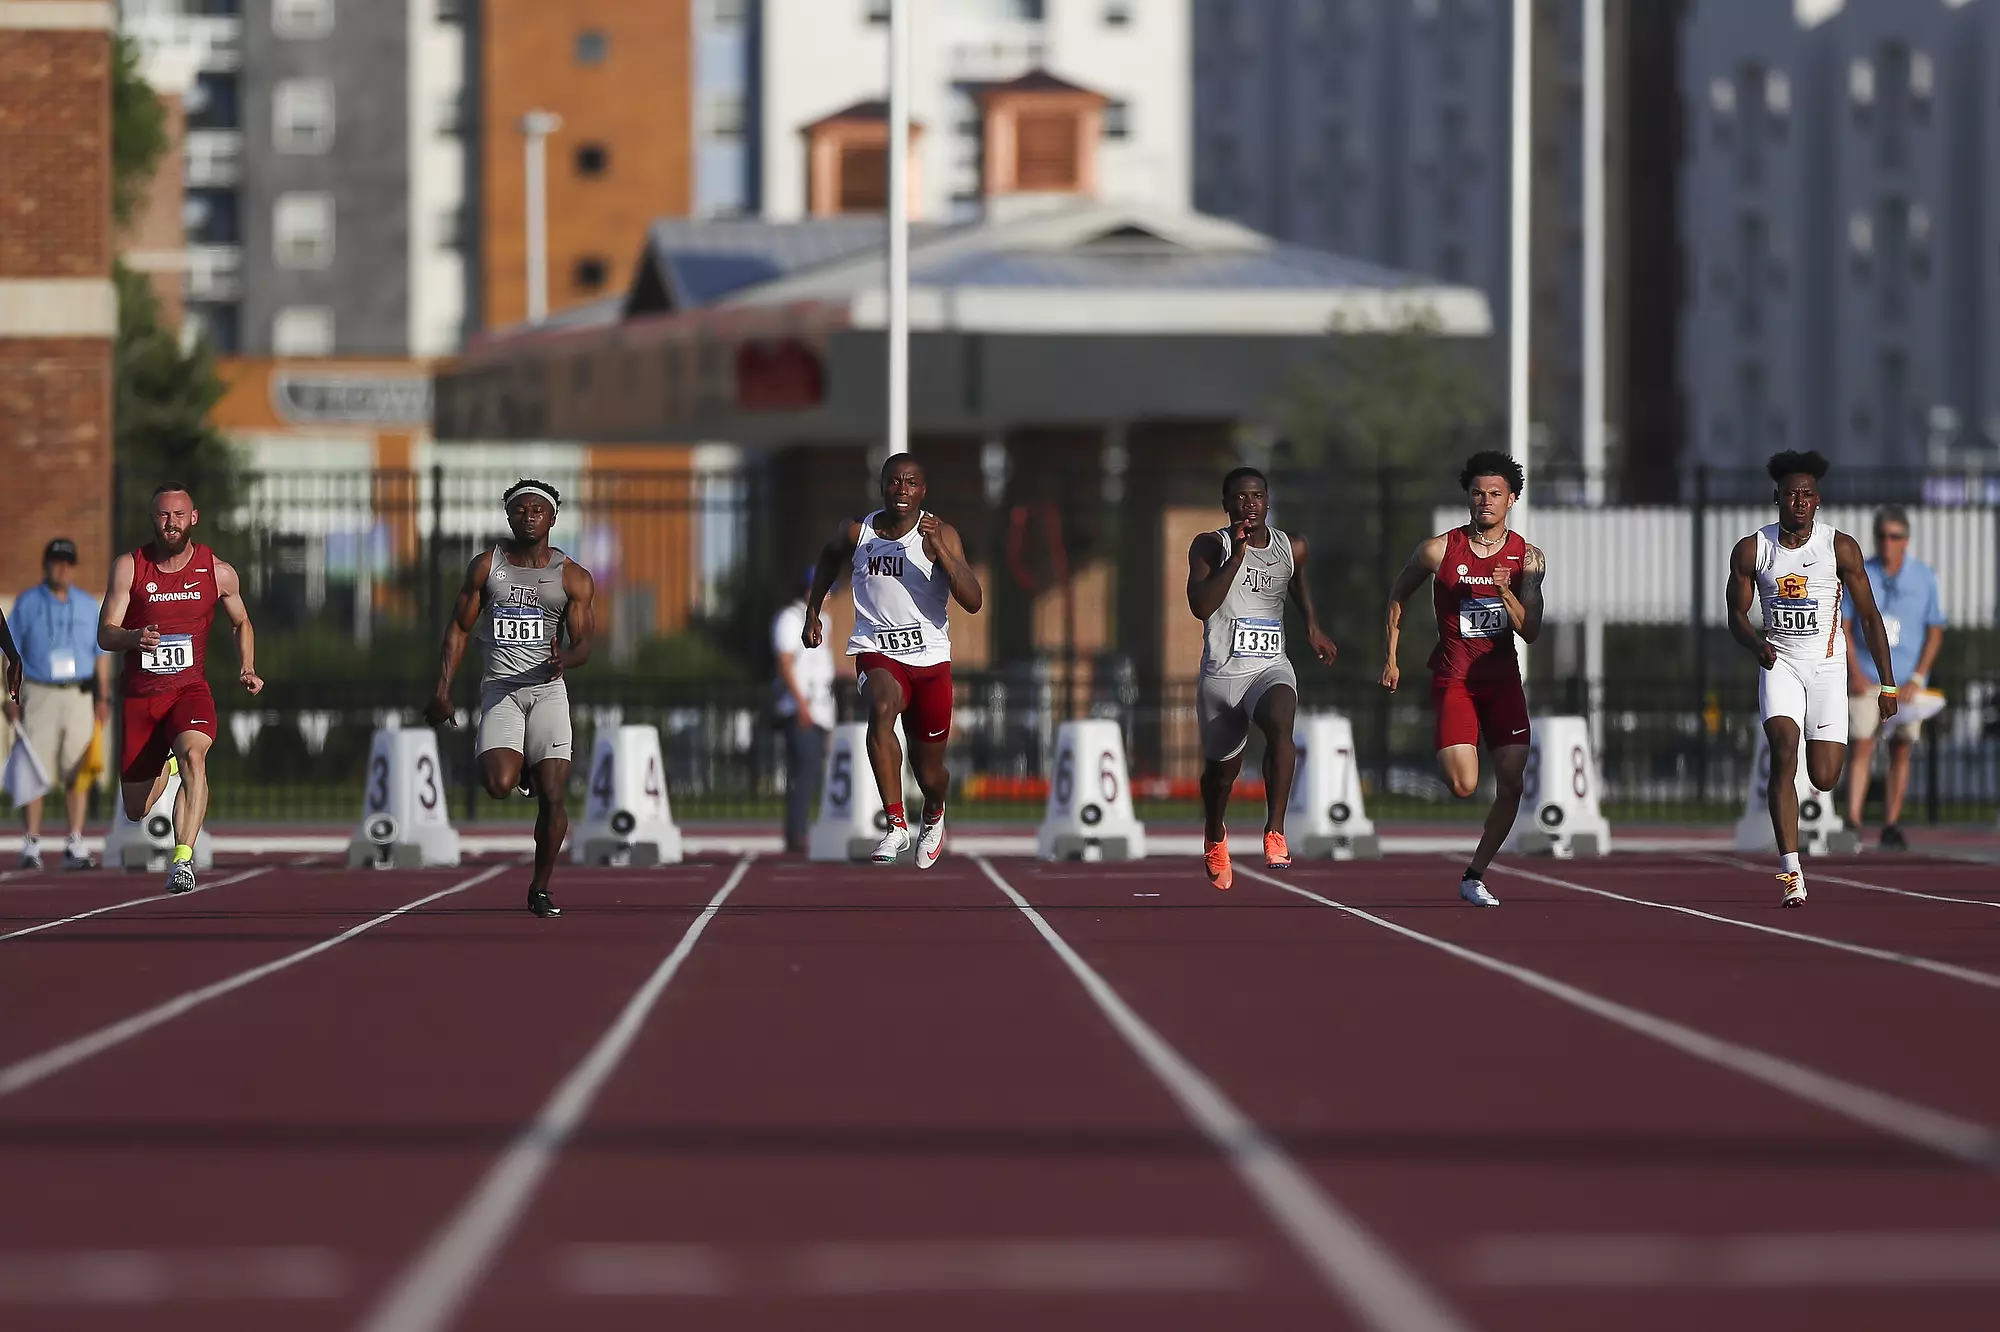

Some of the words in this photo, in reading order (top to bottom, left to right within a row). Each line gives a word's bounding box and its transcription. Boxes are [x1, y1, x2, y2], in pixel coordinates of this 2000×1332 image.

[868, 556, 904, 577] WSU
[149, 591, 201, 602] ARKANSAS
[1468, 610, 1502, 631] 123
[1772, 611, 1818, 630] 1504
[496, 619, 541, 640] 1361
[877, 630, 924, 651] 1639
[1237, 631, 1280, 652] 1339
[369, 755, 390, 811] 3
[417, 755, 438, 810] 3
[592, 753, 615, 809] 4
[645, 755, 660, 807] 4
[830, 752, 853, 807] 5
[1056, 749, 1074, 806] 6
[1100, 751, 1118, 803] 6
[1522, 746, 1542, 799] 8
[1572, 744, 1588, 799] 8
